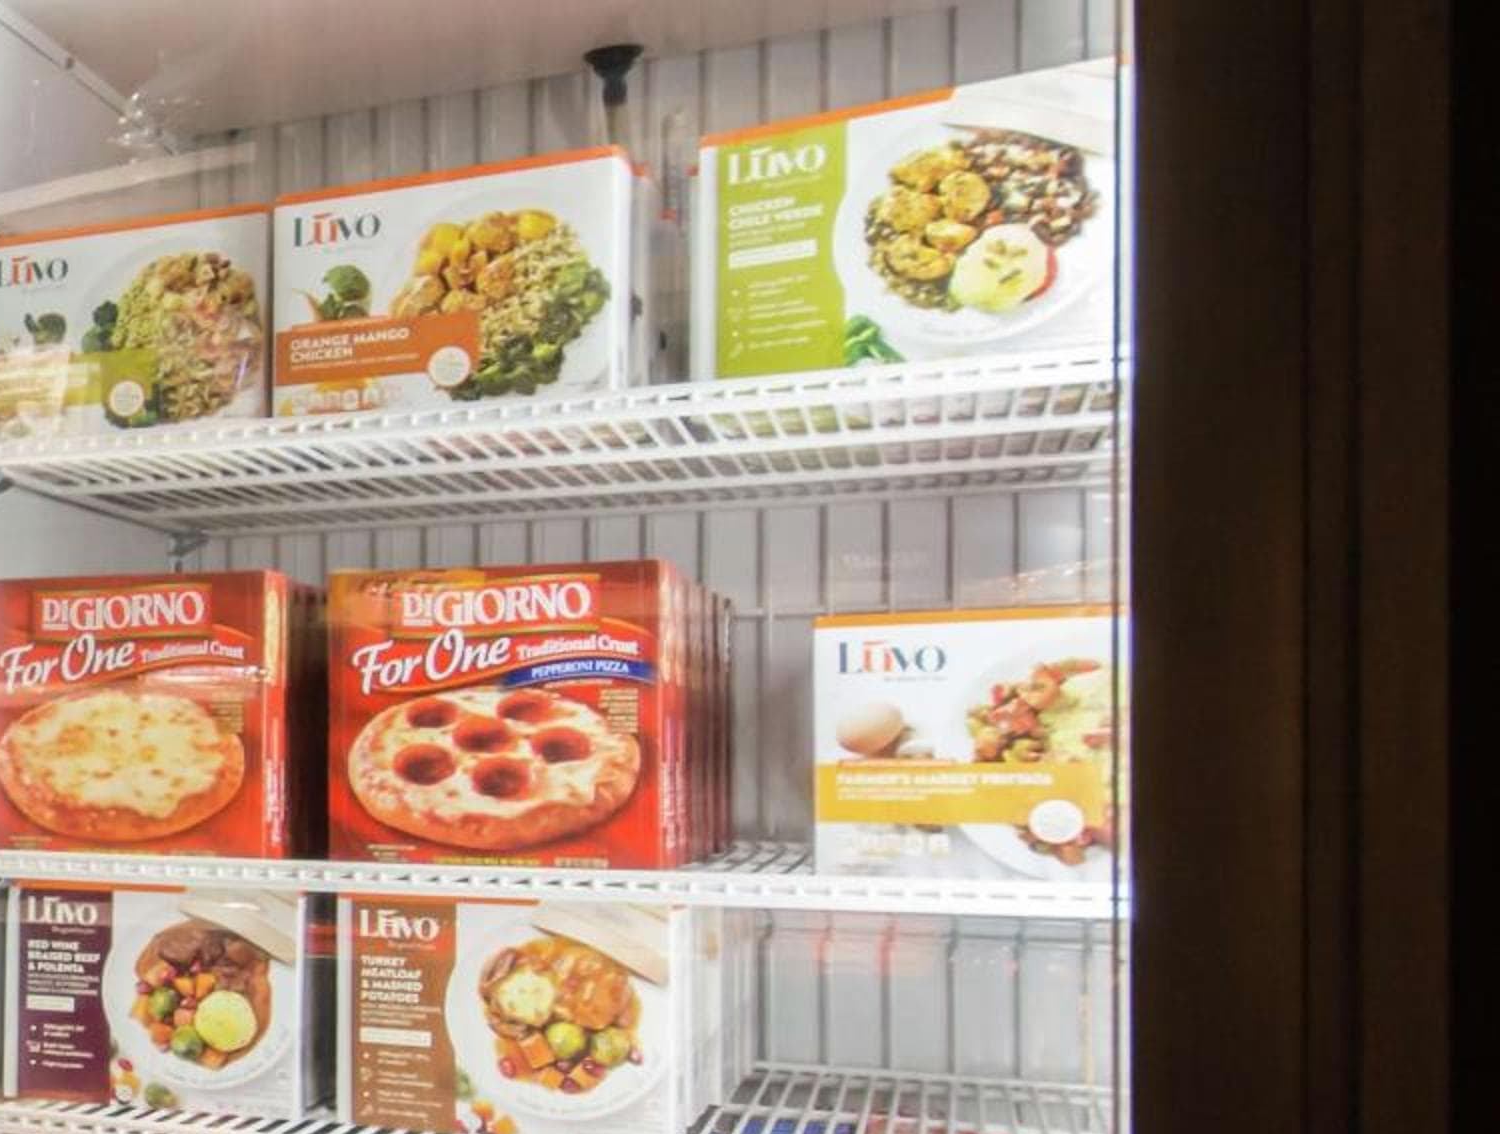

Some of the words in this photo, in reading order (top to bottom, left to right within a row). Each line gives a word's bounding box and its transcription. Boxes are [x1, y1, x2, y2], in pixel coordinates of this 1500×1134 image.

[353, 327, 411, 344] MANGO
[60, 632, 135, 682] One
[141, 640, 209, 663] Traditional
[210, 641, 245, 660] Crust
[351, 640, 423, 695] For
[425, 628, 511, 682] One
[516, 636, 597, 661] Traditional
[596, 634, 640, 656] Crust
[530, 661, 593, 679] PEPPERONI
[595, 659, 630, 676] PIZZA
[37, 962, 85, 974] POLENTA
[360, 955, 407, 967] TURKEY
[360, 966, 423, 980] MEATLOAF
[371, 980, 424, 992] MASHED
[360, 990, 421, 1004] POTATOES
